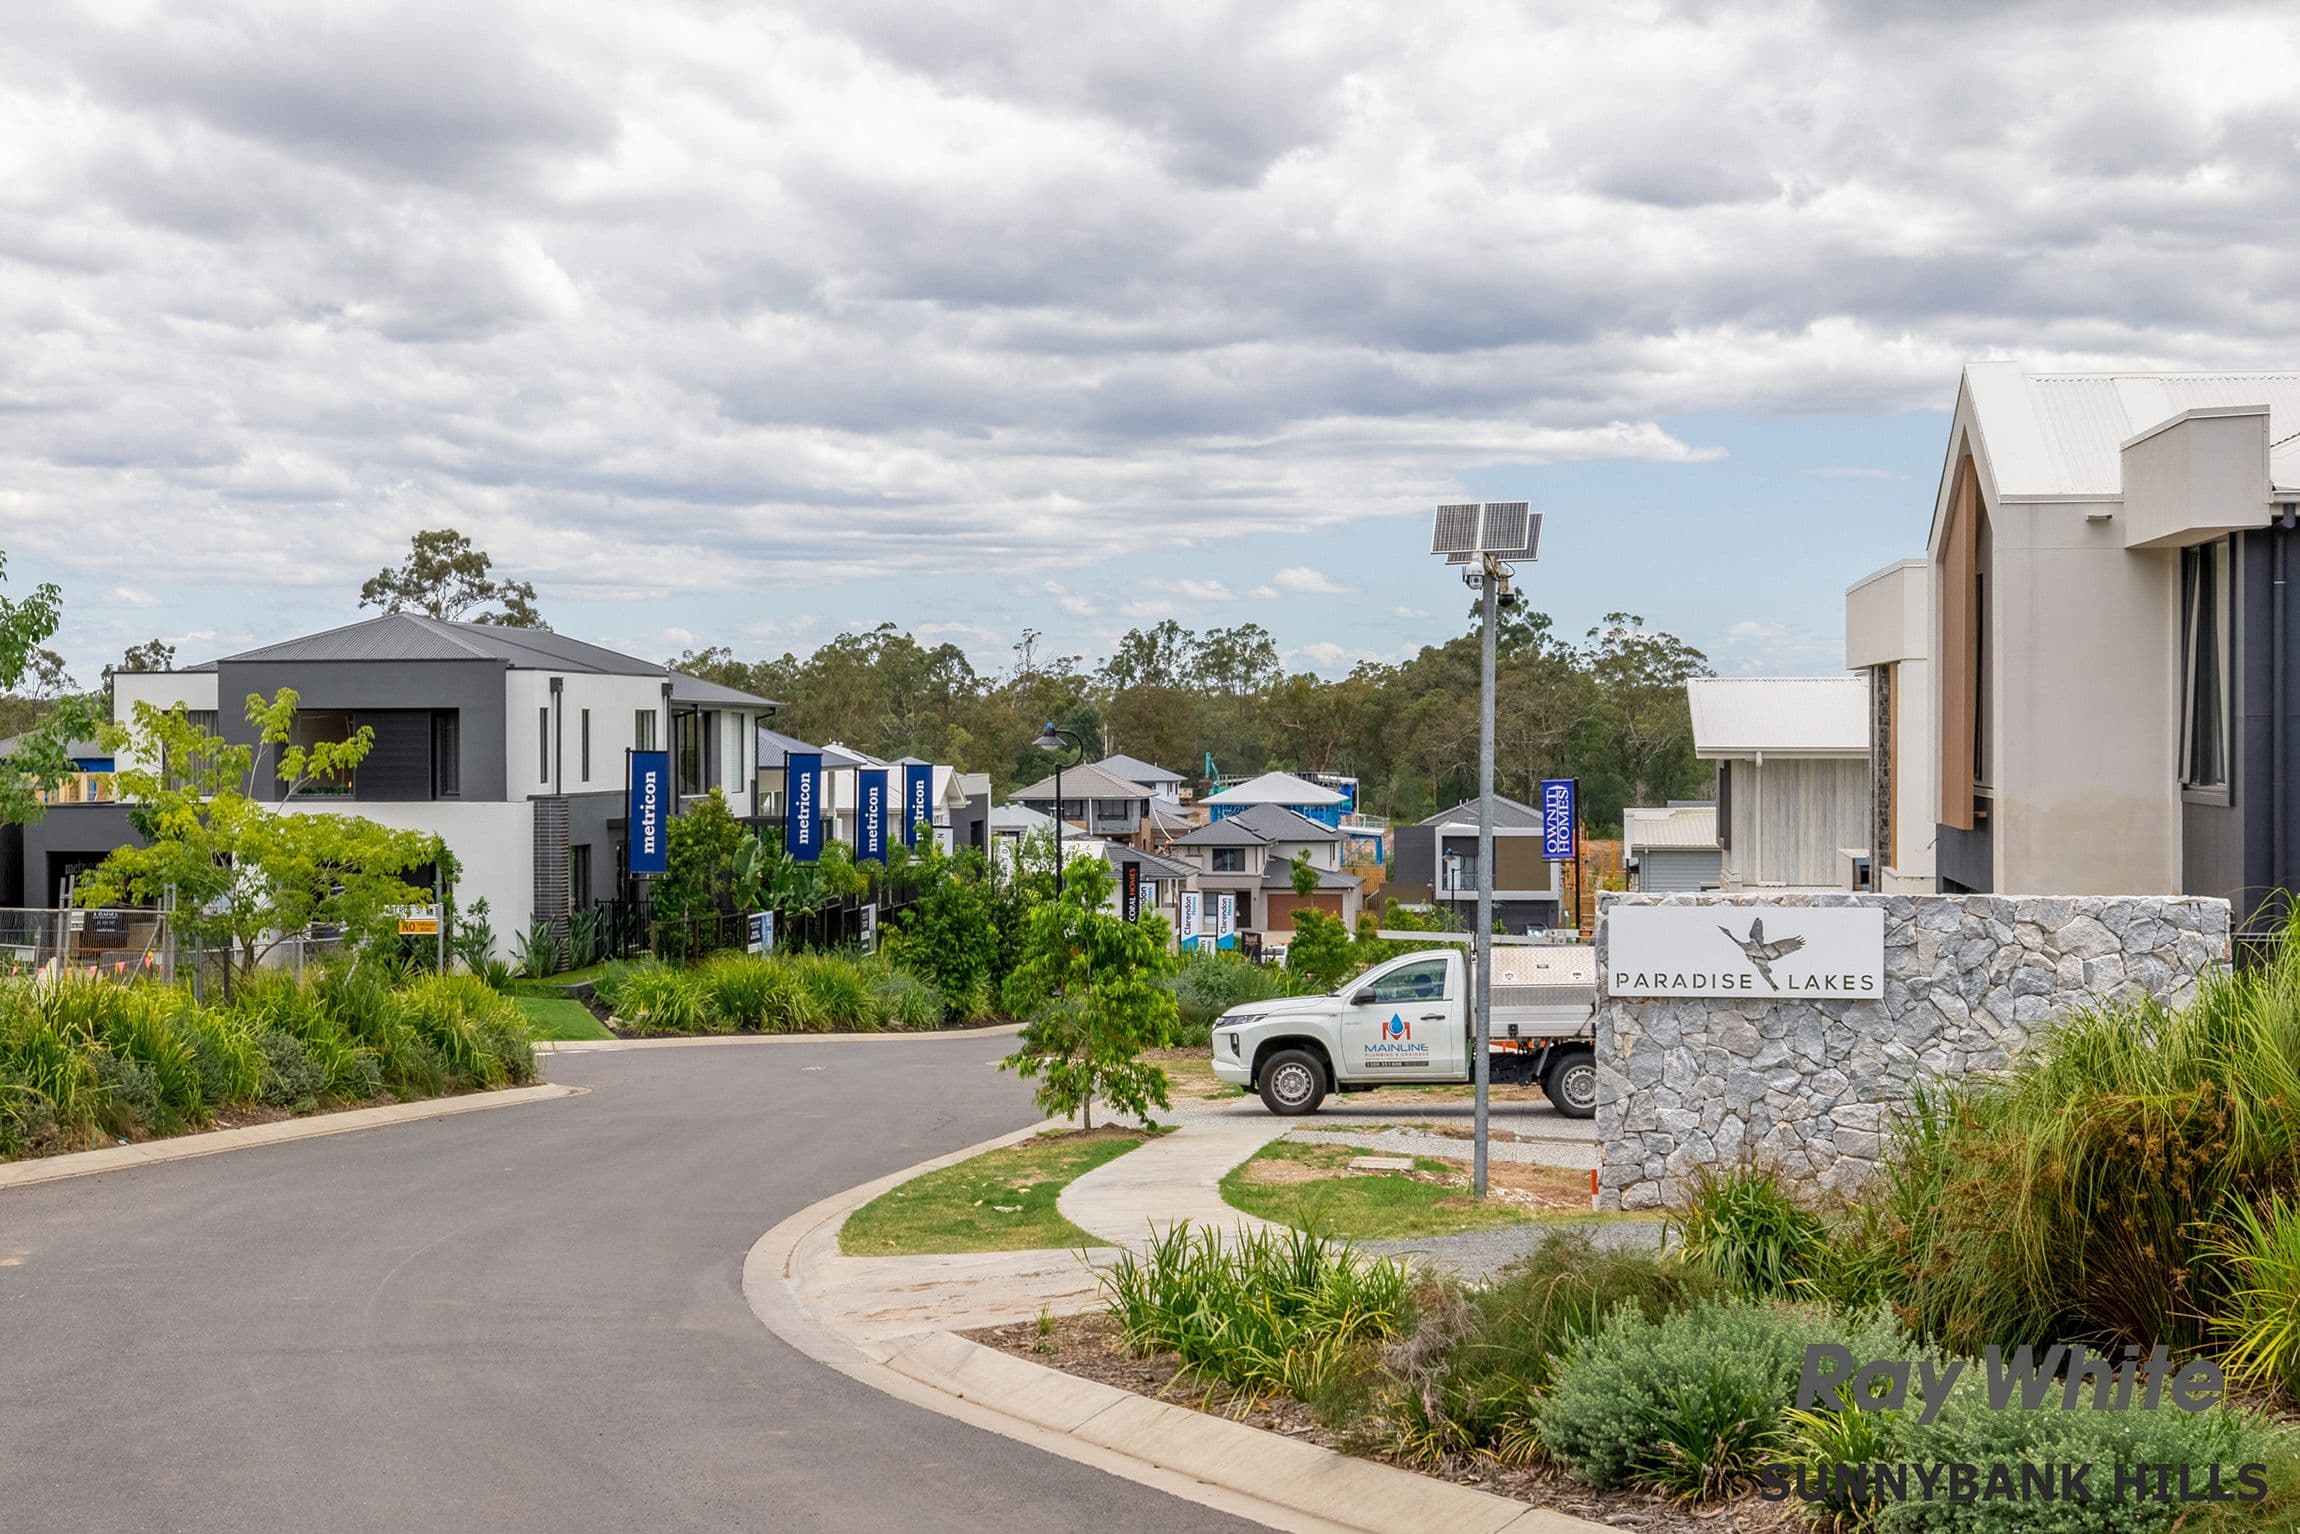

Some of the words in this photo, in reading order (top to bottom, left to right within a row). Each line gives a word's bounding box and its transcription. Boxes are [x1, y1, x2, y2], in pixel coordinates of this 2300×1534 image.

[640, 771, 656, 854] metricon
[796, 772, 811, 845] metricon
[865, 787, 878, 852] metricon
[912, 780, 925, 841] mtricon
[1546, 790, 1558, 853] OWNIT
[1559, 789, 1570, 852] HOMES
[1128, 867, 1136, 896] HOMES
[402, 921, 416, 932] NO
[1128, 896, 1136, 922] CORAL
[1184, 896, 1192, 935] Clarendon
[1615, 973, 1753, 990] PARADISE
[1788, 974, 1875, 991] LAKES
[1364, 1043, 1429, 1053] MAINLINE
